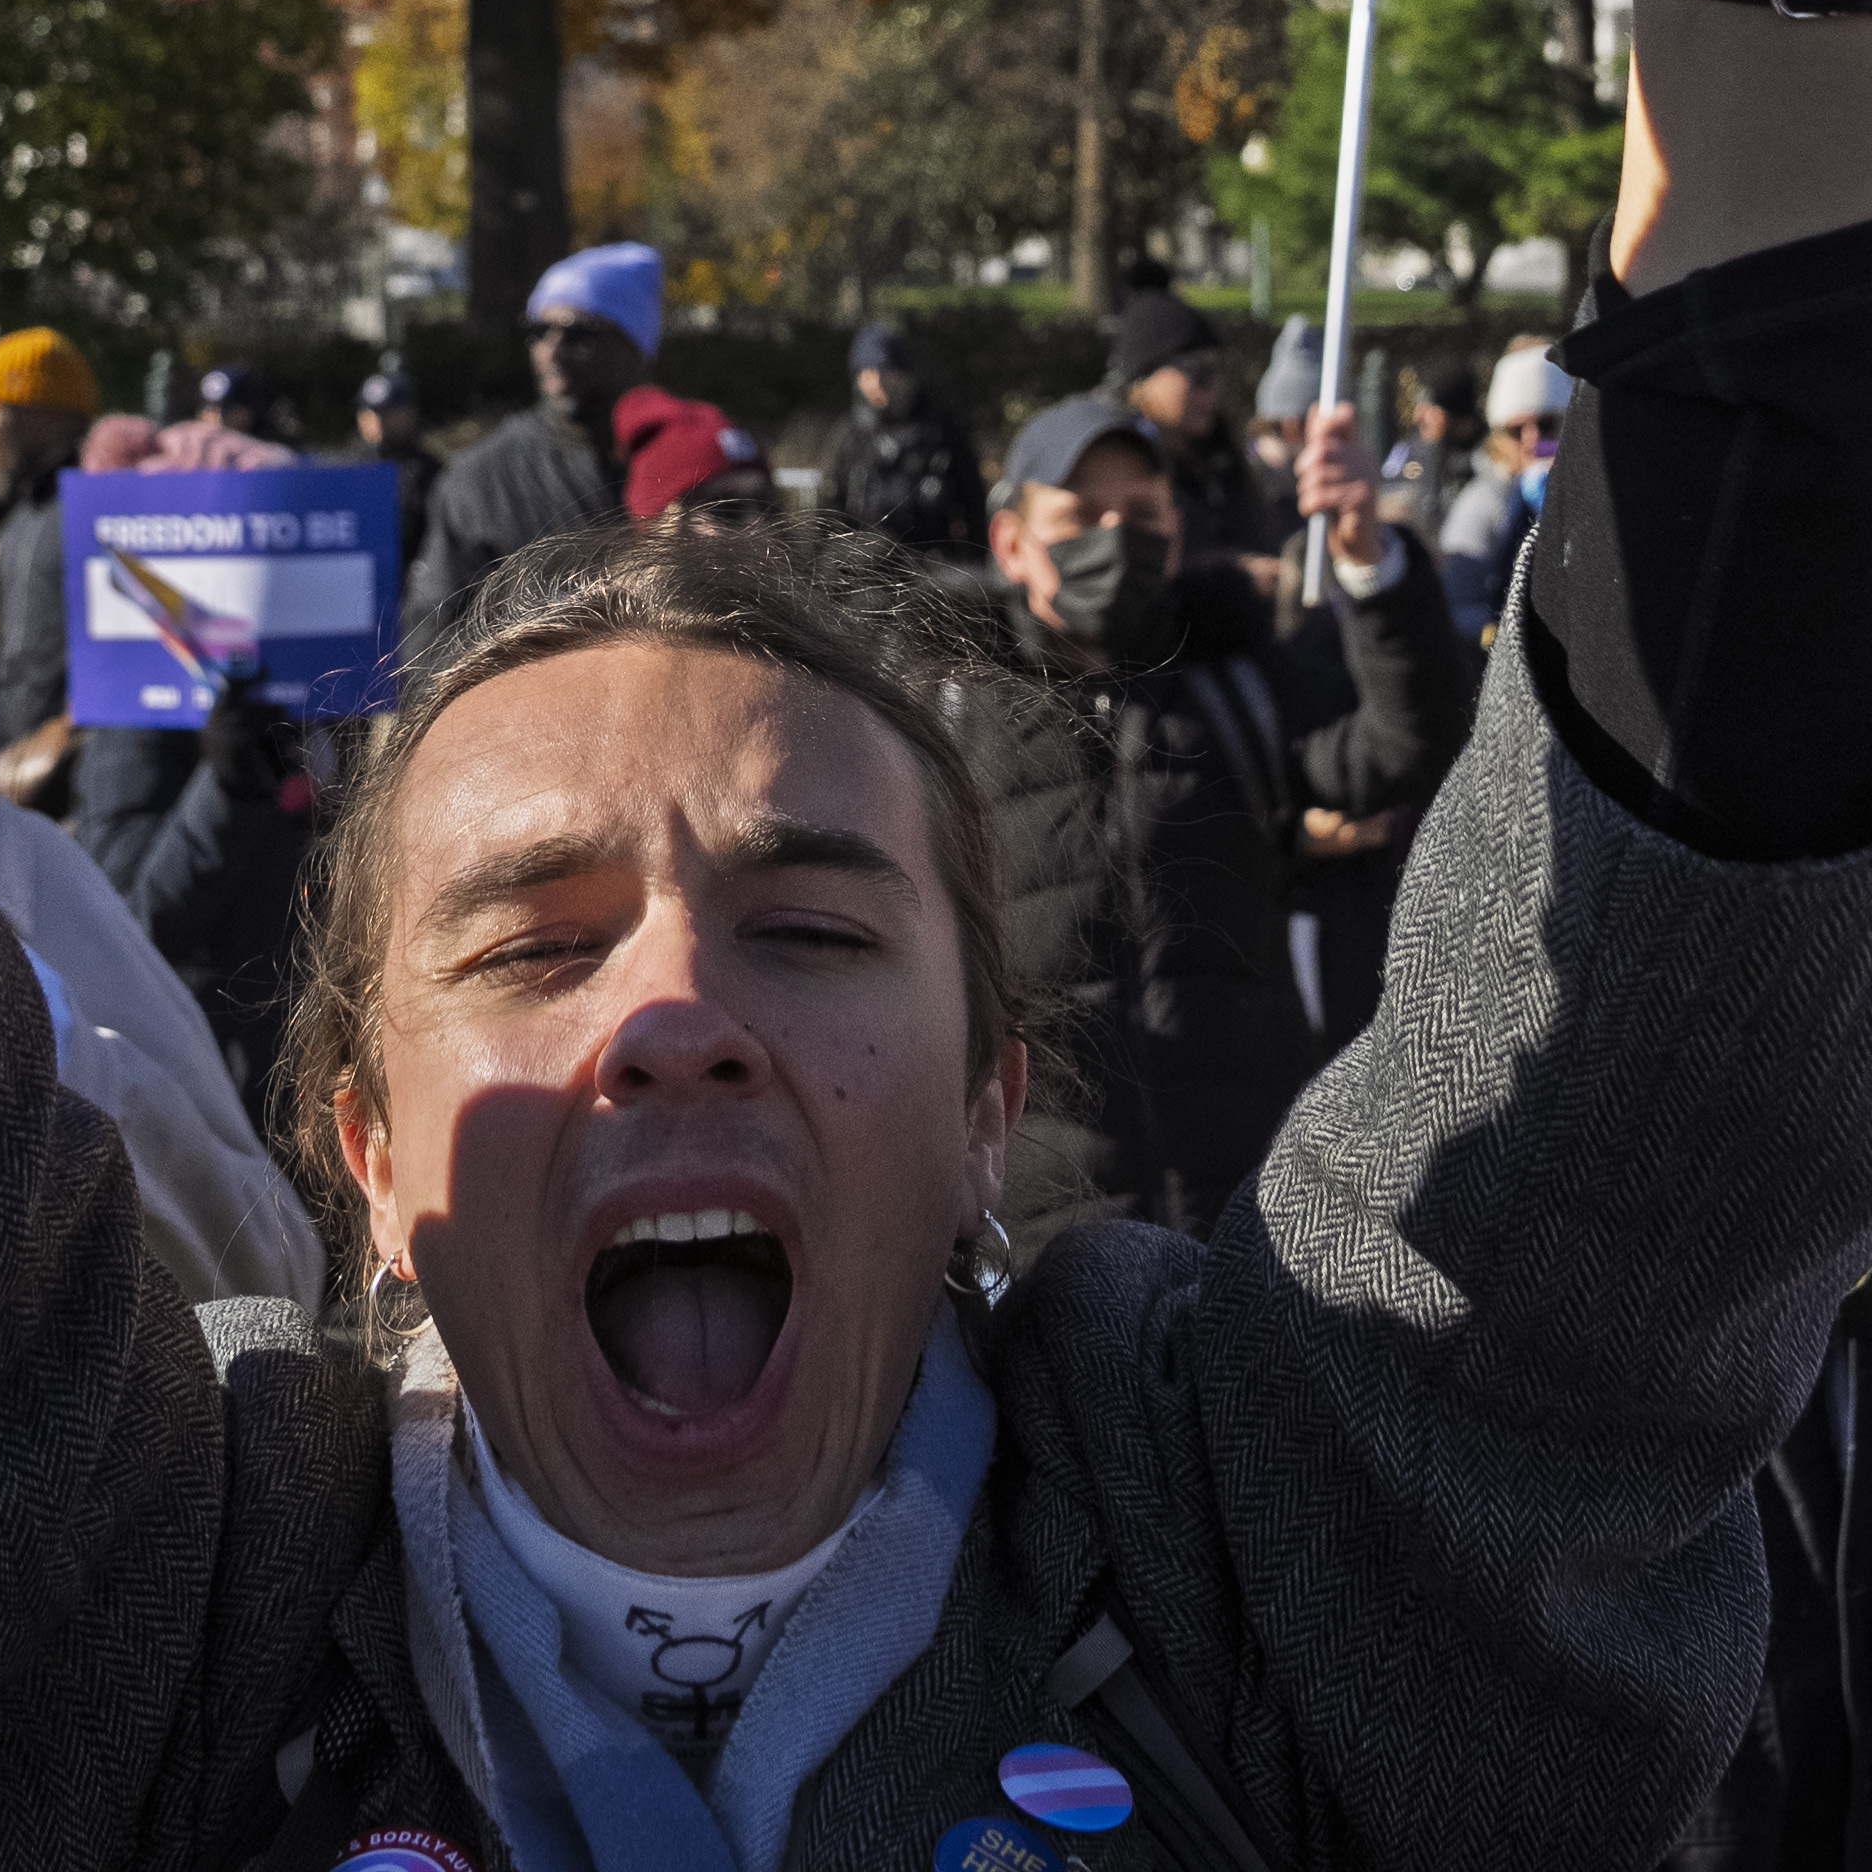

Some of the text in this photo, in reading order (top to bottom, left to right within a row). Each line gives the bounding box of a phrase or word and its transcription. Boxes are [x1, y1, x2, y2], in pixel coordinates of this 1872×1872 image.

[94, 513, 244, 552] FREEDOM
[249, 511, 301, 550] TO
[370, 1830, 447, 1852] BODILY
[981, 1829, 1047, 1872] SHE
